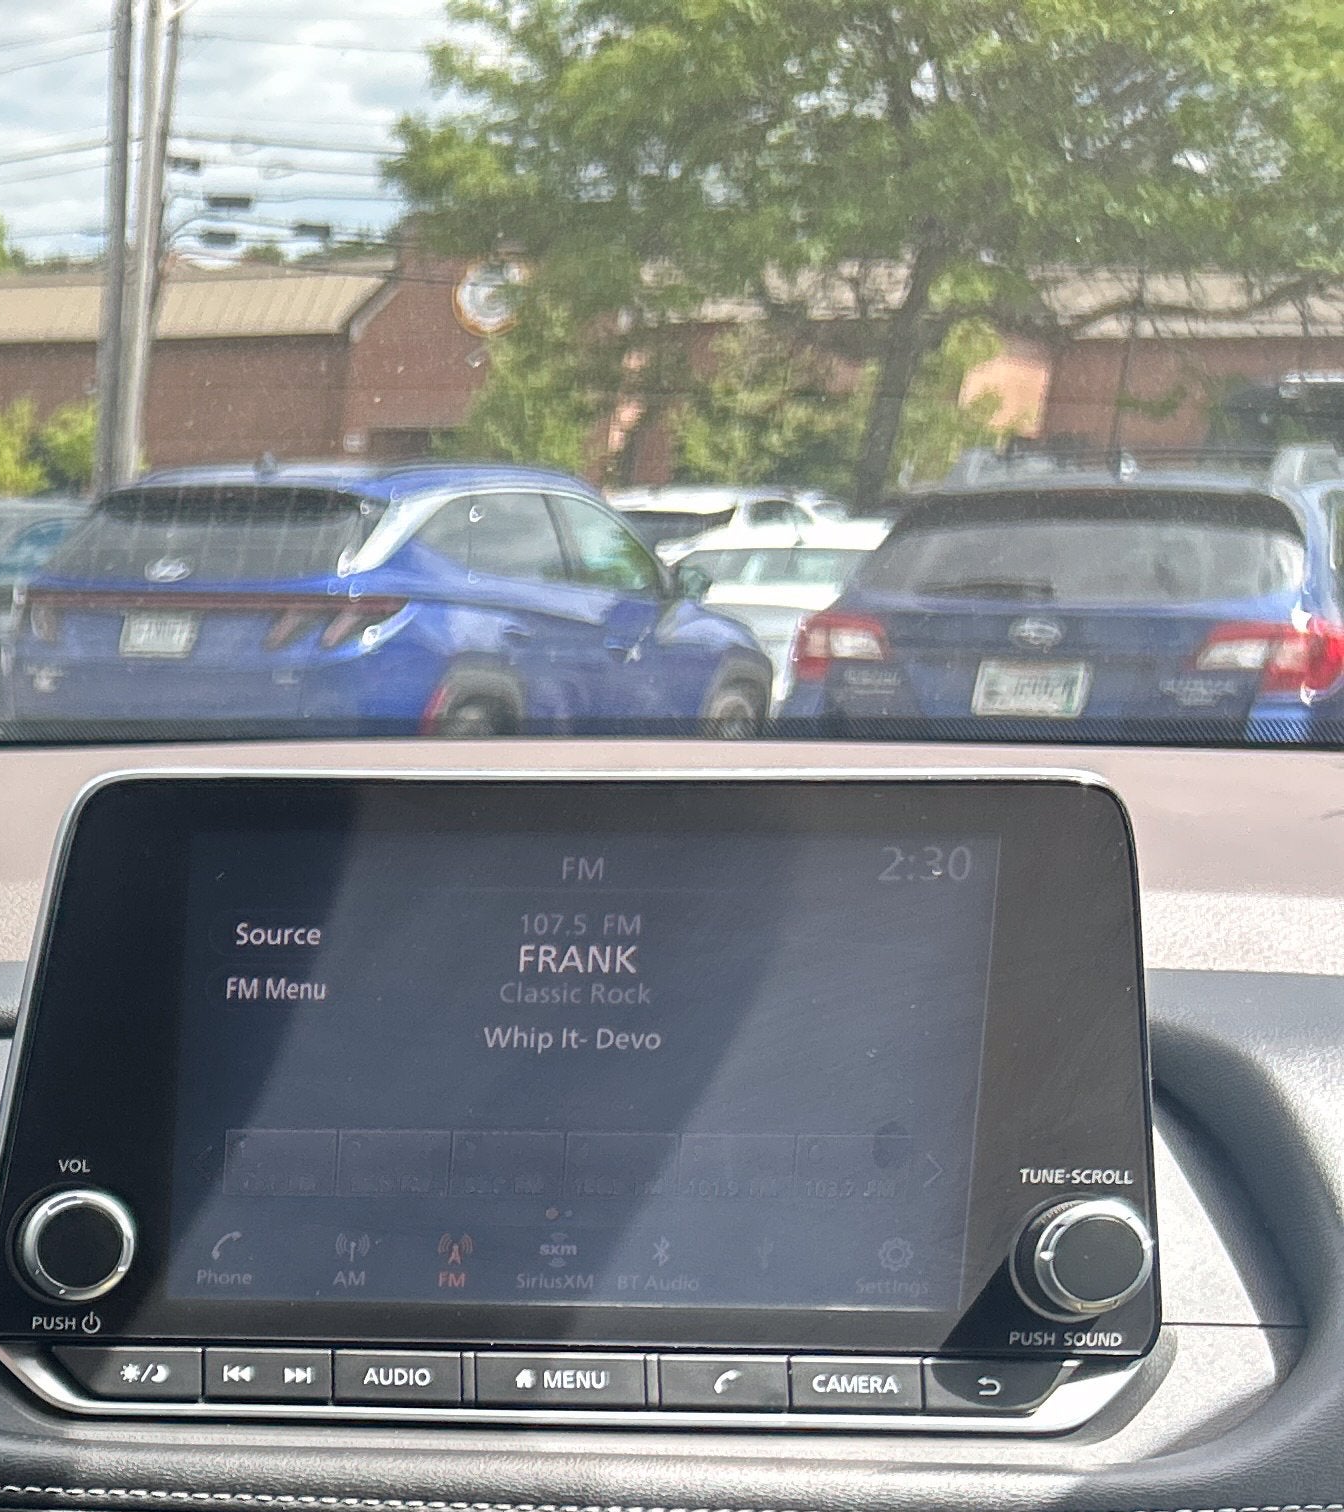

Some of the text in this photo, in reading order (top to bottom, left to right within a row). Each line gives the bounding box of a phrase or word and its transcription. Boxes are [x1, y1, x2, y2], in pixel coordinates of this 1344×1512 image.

[562, 857, 604, 880] FM
[877, 846, 973, 882] 2:30
[235, 922, 322, 946] Source
[520, 913, 642, 937] 107.5 FM
[518, 944, 638, 975] FRANK
[226, 977, 327, 1001] FM Menu
[500, 981, 652, 1005] Classic Rock
[484, 1026, 554, 1054] Whip
[596, 1028, 661, 1051] Devo
[58, 1158, 91, 1175] VOL
[196, 1269, 253, 1286] Phone
[332, 1270, 366, 1287] AM
[438, 1271, 466, 1288] FM
[516, 1272, 595, 1290] SiriusXM
[616, 1273, 700, 1292] BT Audio
[855, 1276, 930, 1297] Settings
[31, 1316, 77, 1332] PUSH
[1009, 1330, 1123, 1348] PUSH SOUND
[363, 1367, 431, 1387] AUDIO
[543, 1369, 607, 1390] MENU
[812, 1374, 899, 1395] CAMERA
